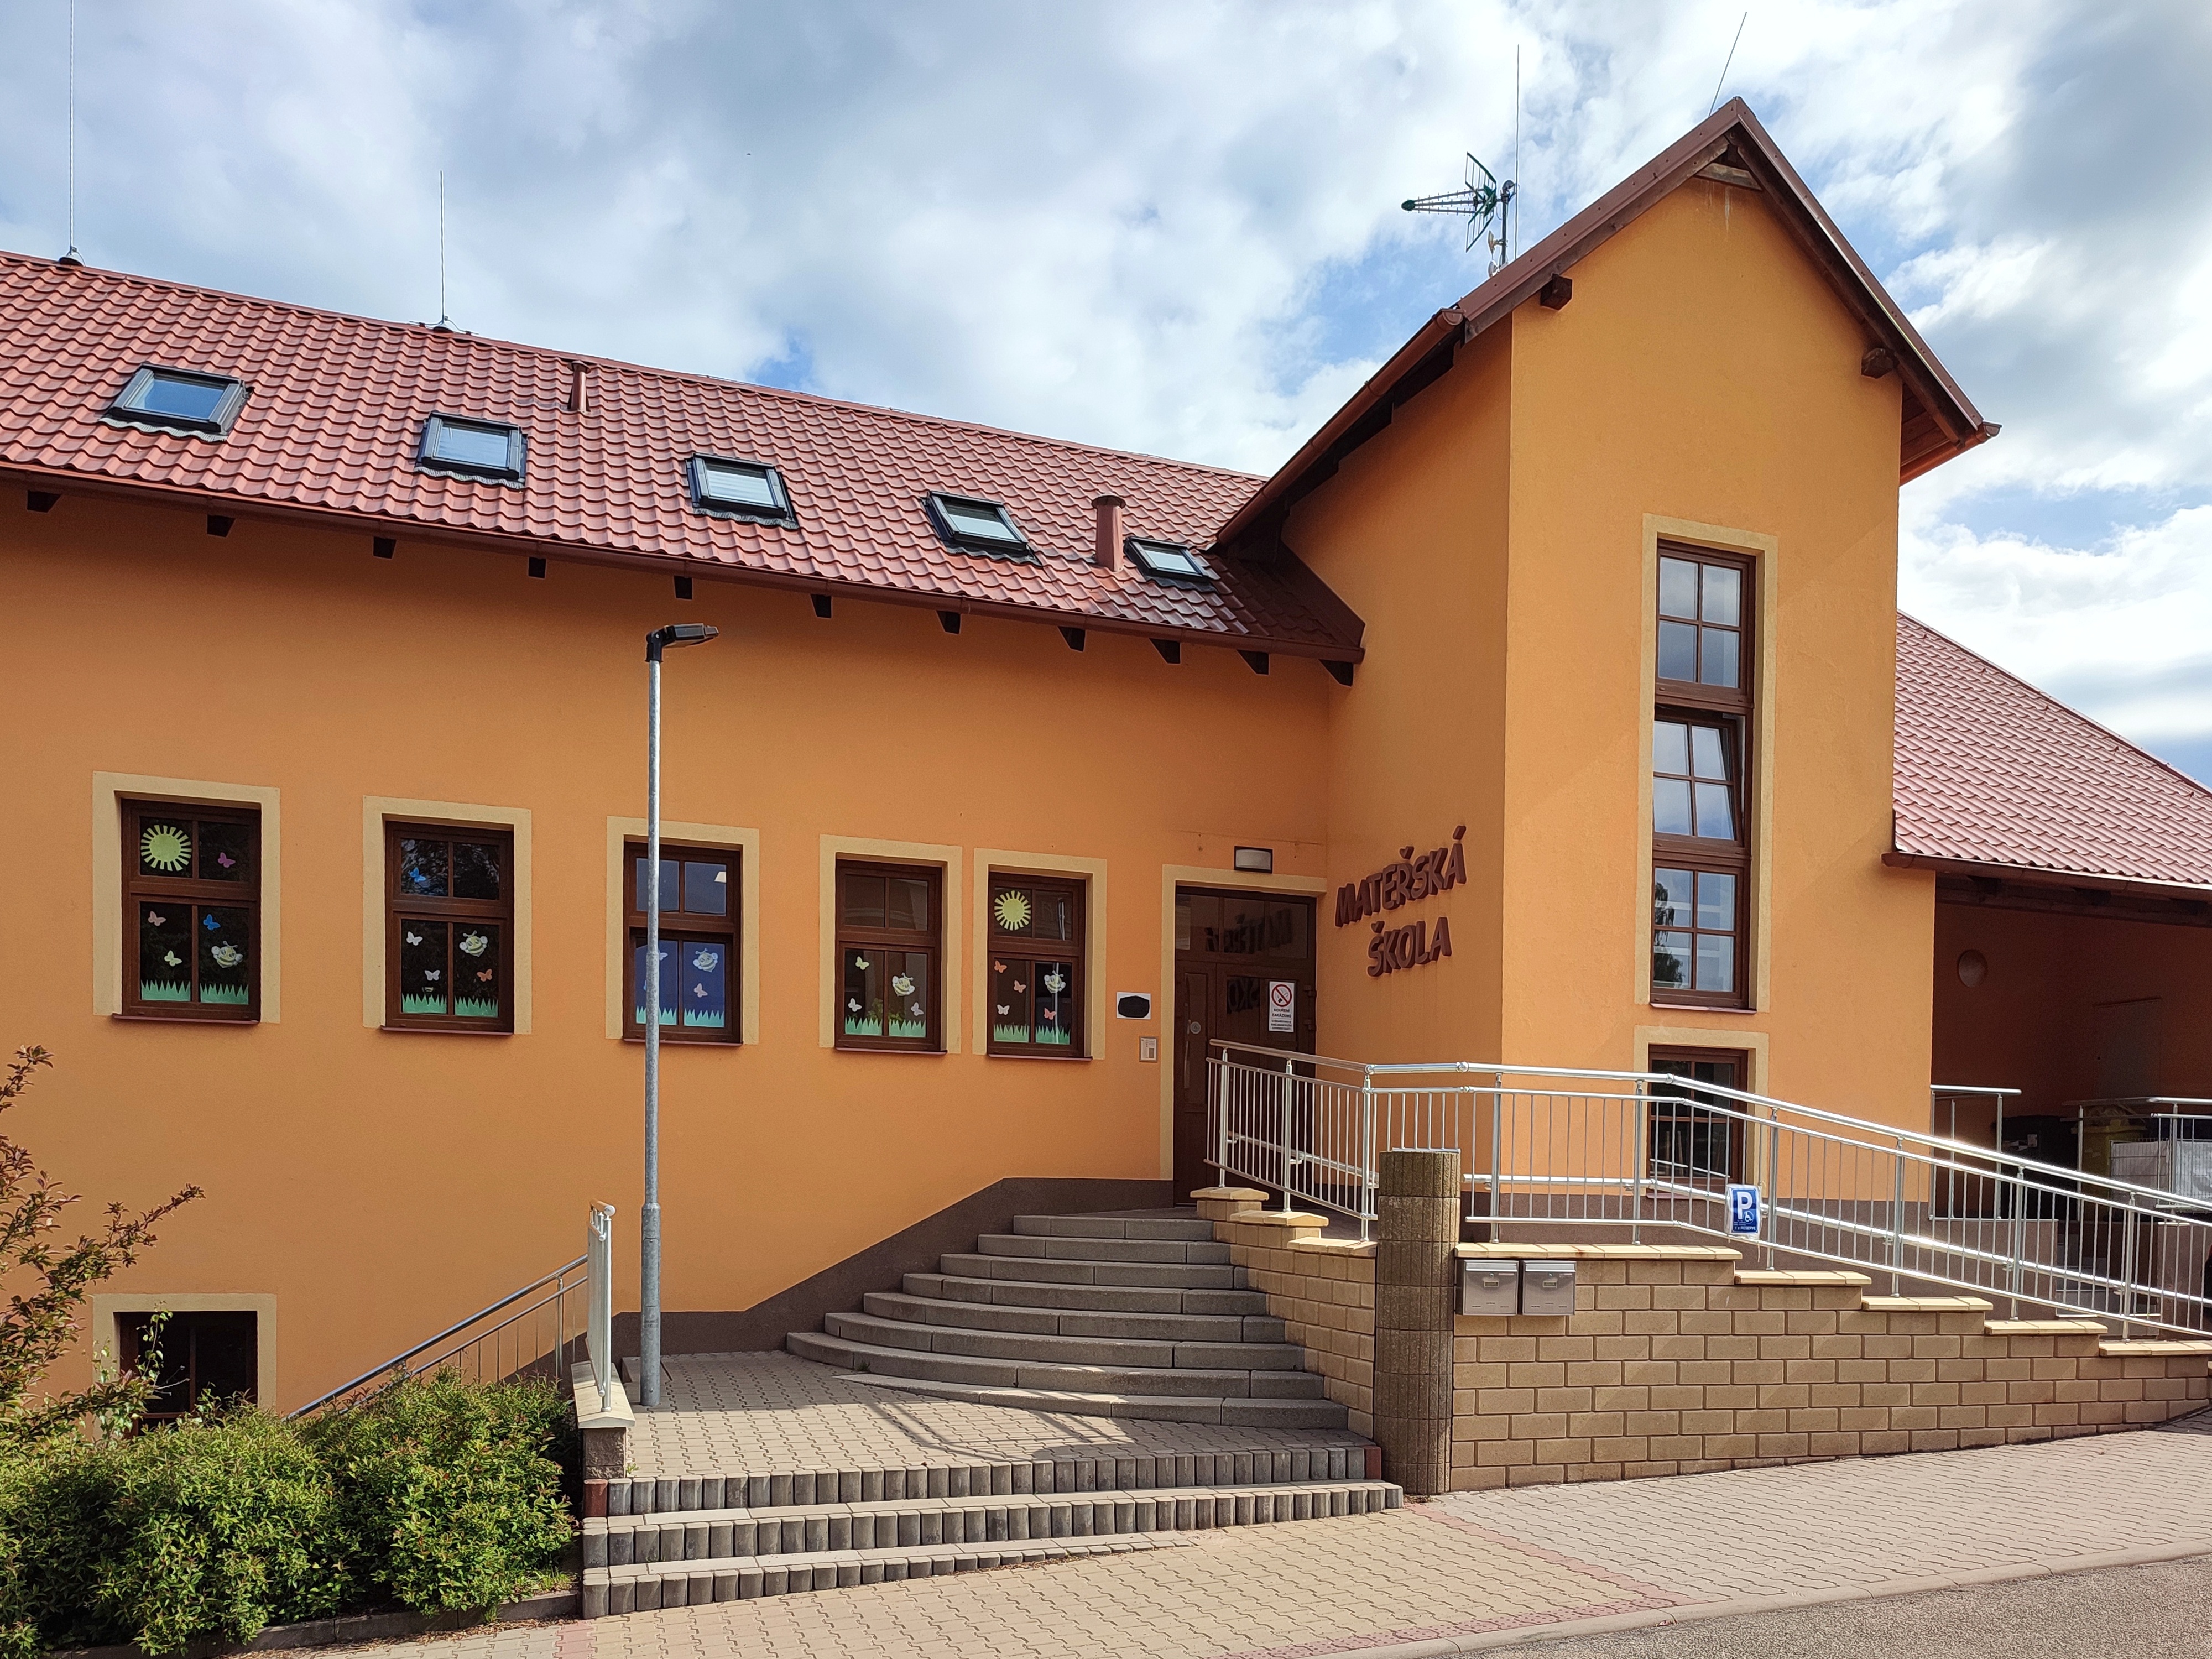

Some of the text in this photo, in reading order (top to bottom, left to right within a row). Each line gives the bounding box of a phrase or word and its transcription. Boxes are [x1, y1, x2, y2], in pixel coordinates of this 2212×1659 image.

[1335, 826, 1467, 927] MATEŘSKÁ
[1367, 917, 1452, 977] ŠKOLA
[1737, 1191, 1752, 1219] P
